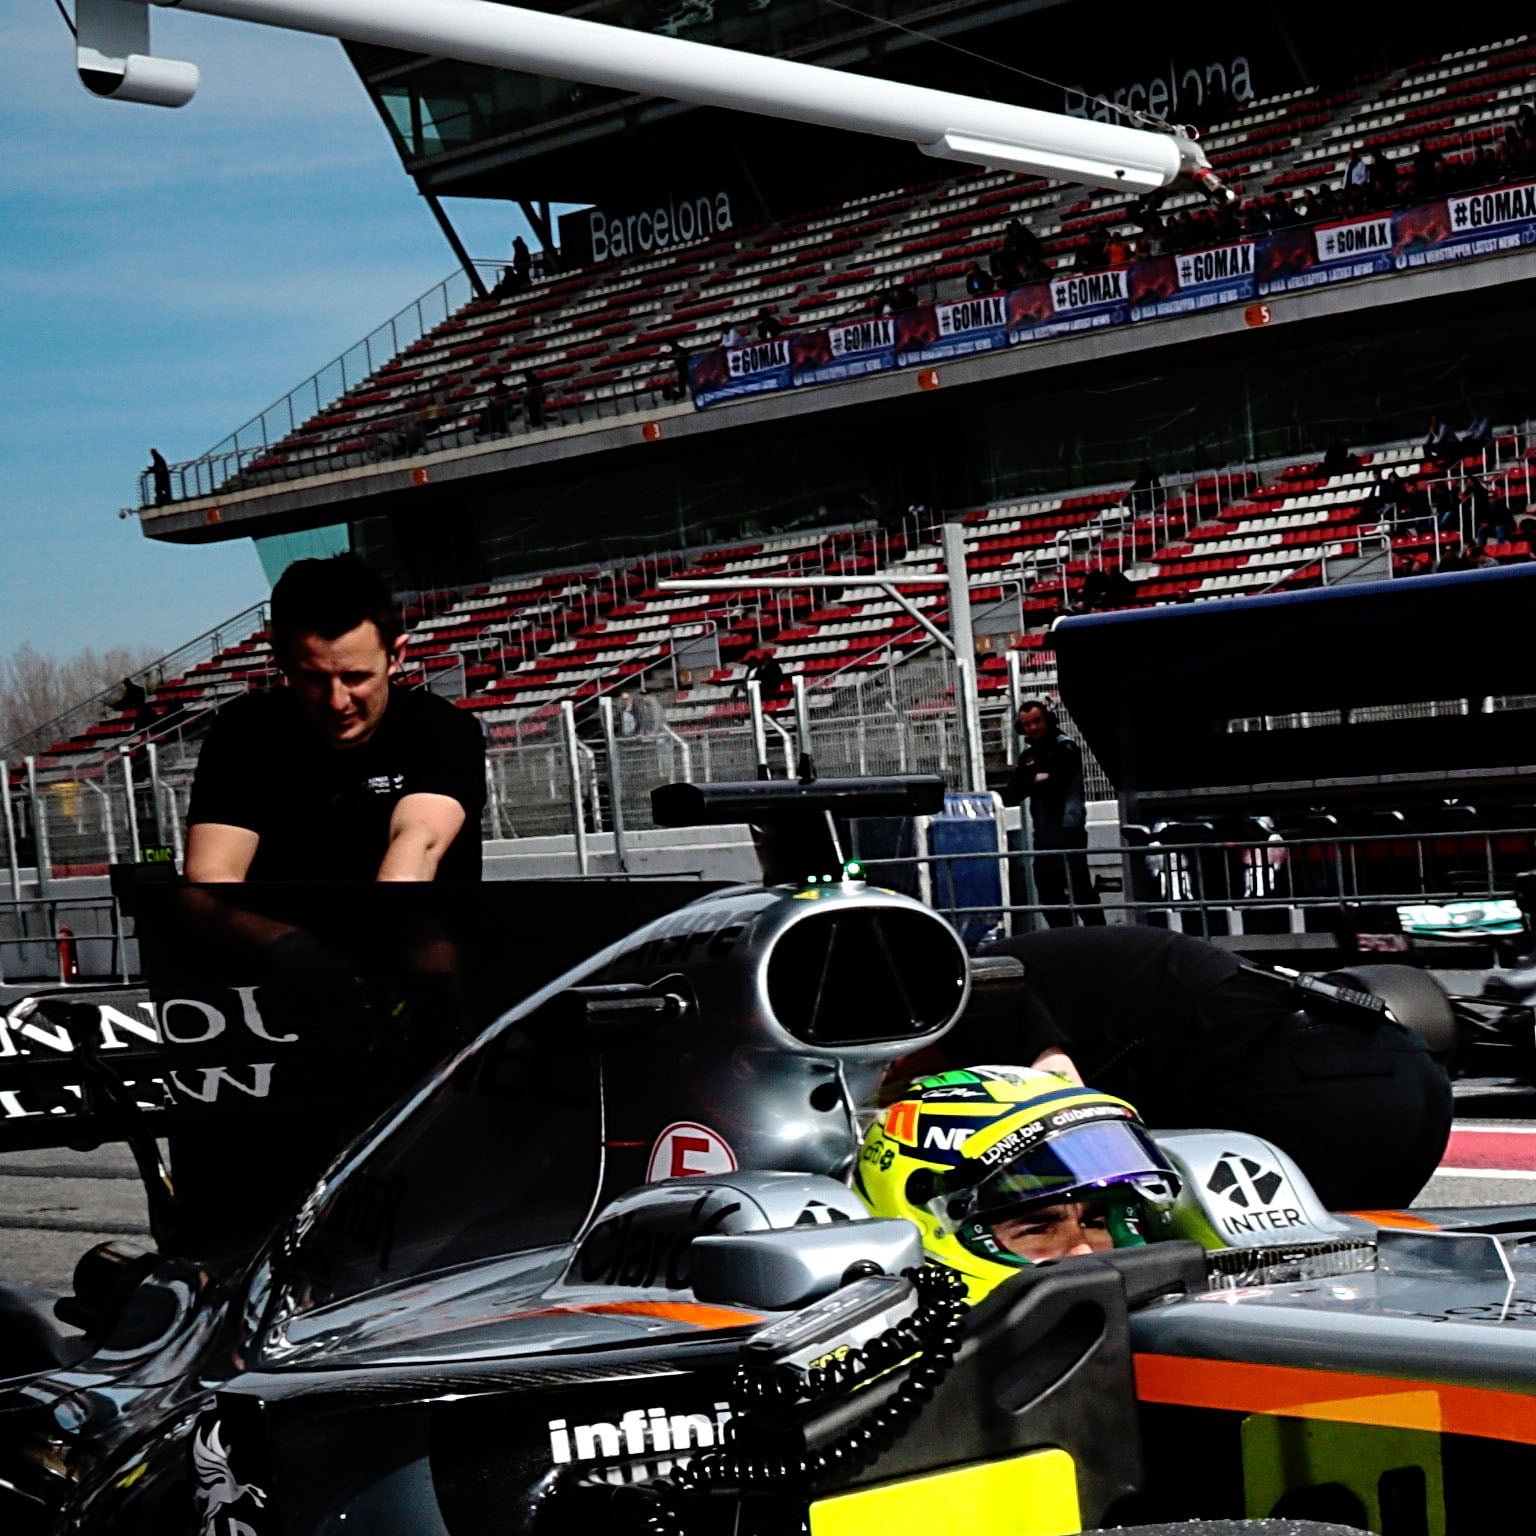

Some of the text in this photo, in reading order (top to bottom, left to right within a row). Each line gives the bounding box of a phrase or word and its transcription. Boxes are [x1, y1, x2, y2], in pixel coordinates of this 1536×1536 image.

[588, 190, 733, 263] Barcelona
[1325, 222, 1389, 254] #GOMAX
[1181, 244, 1251, 284] #GOMAX
[1054, 277, 1123, 308] #GOMAX
[941, 296, 1003, 333] #GOMAX
[1260, 306, 1271, 323] 5
[832, 318, 893, 353] #GOMAX
[731, 341, 787, 375] #GOMAX
[980, 1120, 1045, 1166] LDNR.biz
[1222, 1207, 1306, 1235] INTER
